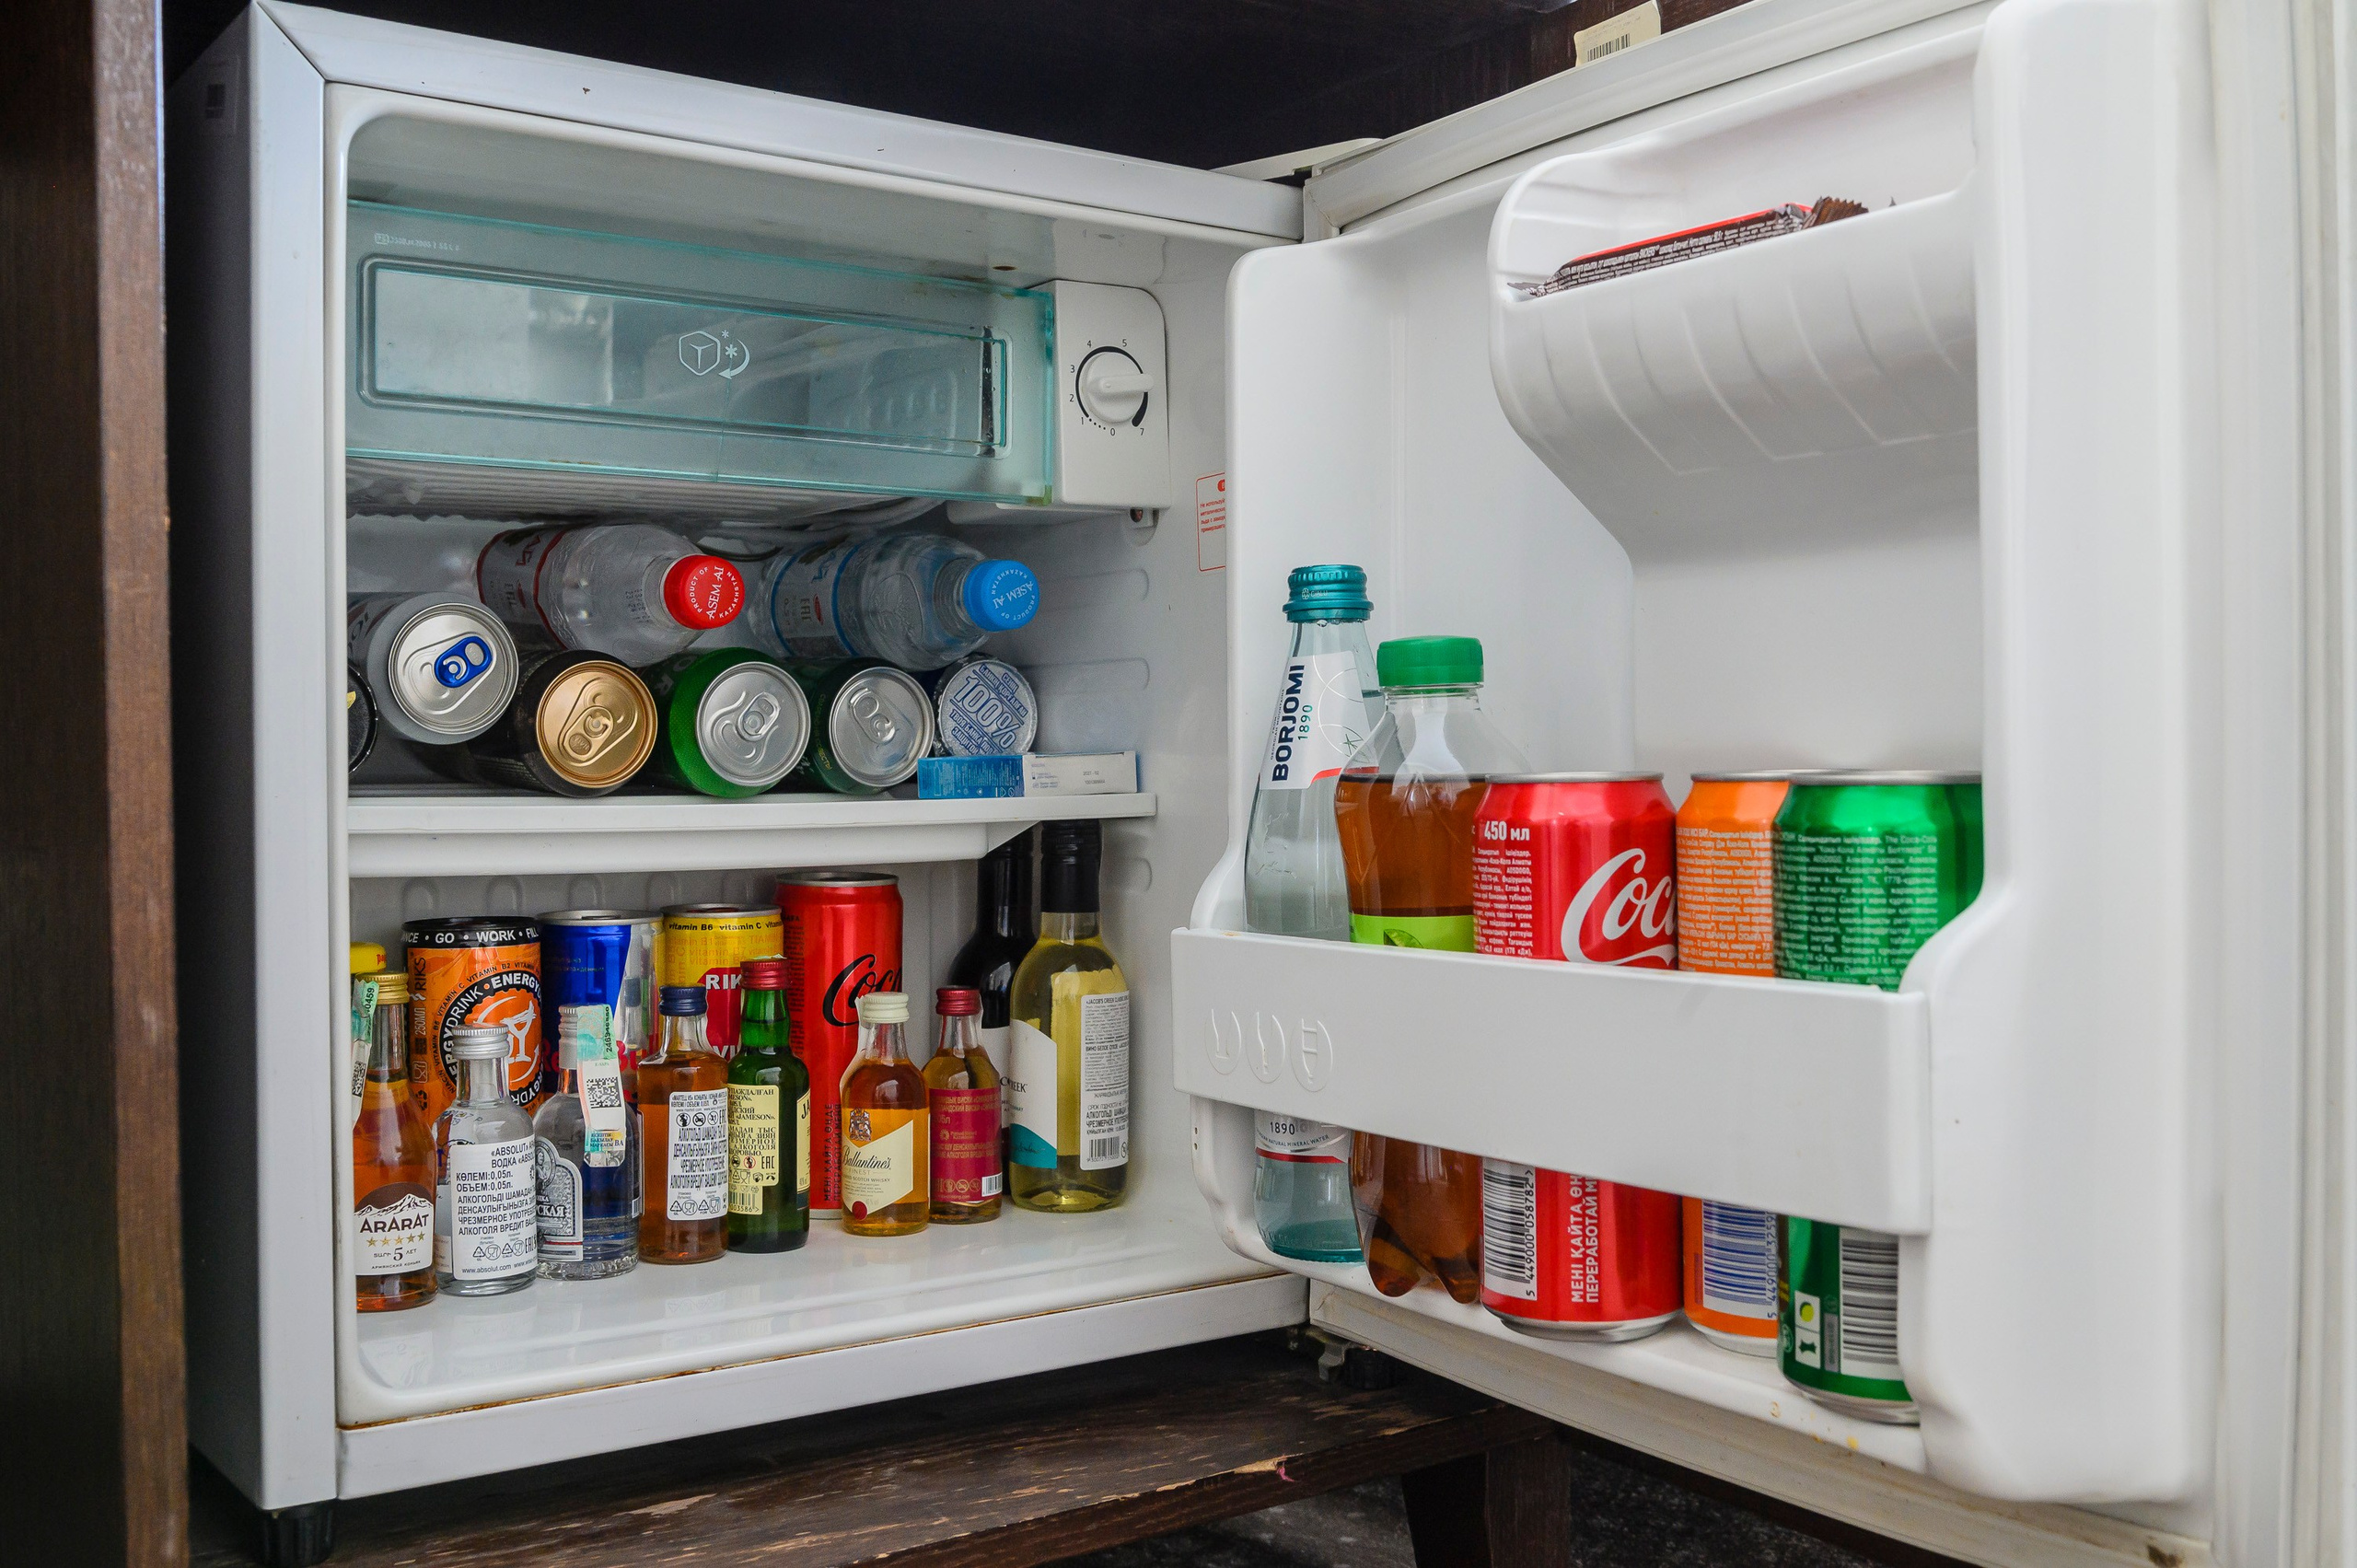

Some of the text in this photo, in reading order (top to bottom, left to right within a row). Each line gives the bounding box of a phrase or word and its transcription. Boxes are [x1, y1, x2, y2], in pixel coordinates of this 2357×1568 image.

[1086, 340, 1092, 348] 4
[1121, 339, 1128, 347] 5
[1070, 365, 1075, 374] 3
[1069, 394, 1074, 402] 2
[1080, 416, 1085, 425] 1
[1109, 427, 1116, 436] 0
[1139, 427, 1145, 436] 7
[689, 566, 709, 613] PRODUCT OF
[991, 569, 1028, 595] KAZAKHSTAN
[705, 565, 725, 621] ASEM AI
[718, 571, 739, 619] KAZAKHSTAN
[992, 580, 1034, 610] ASEM AI
[1013, 595, 1036, 621] PRODUCT
[949, 708, 970, 730] ТВОЯ
[954, 676, 1020, 749] 100%
[1271, 664, 1306, 782] BORJOMI
[1297, 704, 1314, 741] 1890
[1483, 820, 1508, 841] 450
[1510, 828, 1531, 842] мл
[668, 922, 698, 931] vitamin
[719, 923, 754, 932] vitamin
[756, 922, 762, 930] C
[435, 933, 455, 944] GO
[476, 929, 517, 943] WORK
[414, 957, 426, 992] RIKS
[705, 974, 742, 991] RIK
[432, 1035, 440, 1067] VITAMIN
[436, 990, 458, 1016] VITAMIN
[466, 965, 498, 983] VITAMIN
[1086, 1118, 1114, 1129] ЧРЕЗМЕРНОЕ
[1270, 1121, 1295, 1135] 1890
[1268, 1138, 1287, 1147] NATURAL
[1309, 1133, 1330, 1144] WATER
[491, 1156, 517, 1169] ВОДКА
[761, 1156, 775, 1169] EAC
[842, 1144, 891, 1170] Ballantine's
[458, 1192, 505, 1204] АЛКОГОЛЬДІ
[1524, 1181, 1536, 1228] 058782
[458, 1213, 508, 1225] ЧРЕЗМЕРНОЕ
[537, 1204, 565, 1217] СКАЯ
[360, 1213, 430, 1234] ARARAT
[459, 1225, 498, 1236] АЛКОГОЛЯ
[499, 1220, 525, 1234] ВРЕДИТ
[393, 1247, 403, 1261] 5
[1524, 1234, 1536, 1281] 449000
[1567, 1202, 1585, 1303] МЕНІ ҚАЙТА
[1582, 1198, 1599, 1304] ПЕРЕРАБОТАЙ
[461, 1263, 512, 1273] www.absolut.com
[1766, 1253, 1777, 1303] 449000
